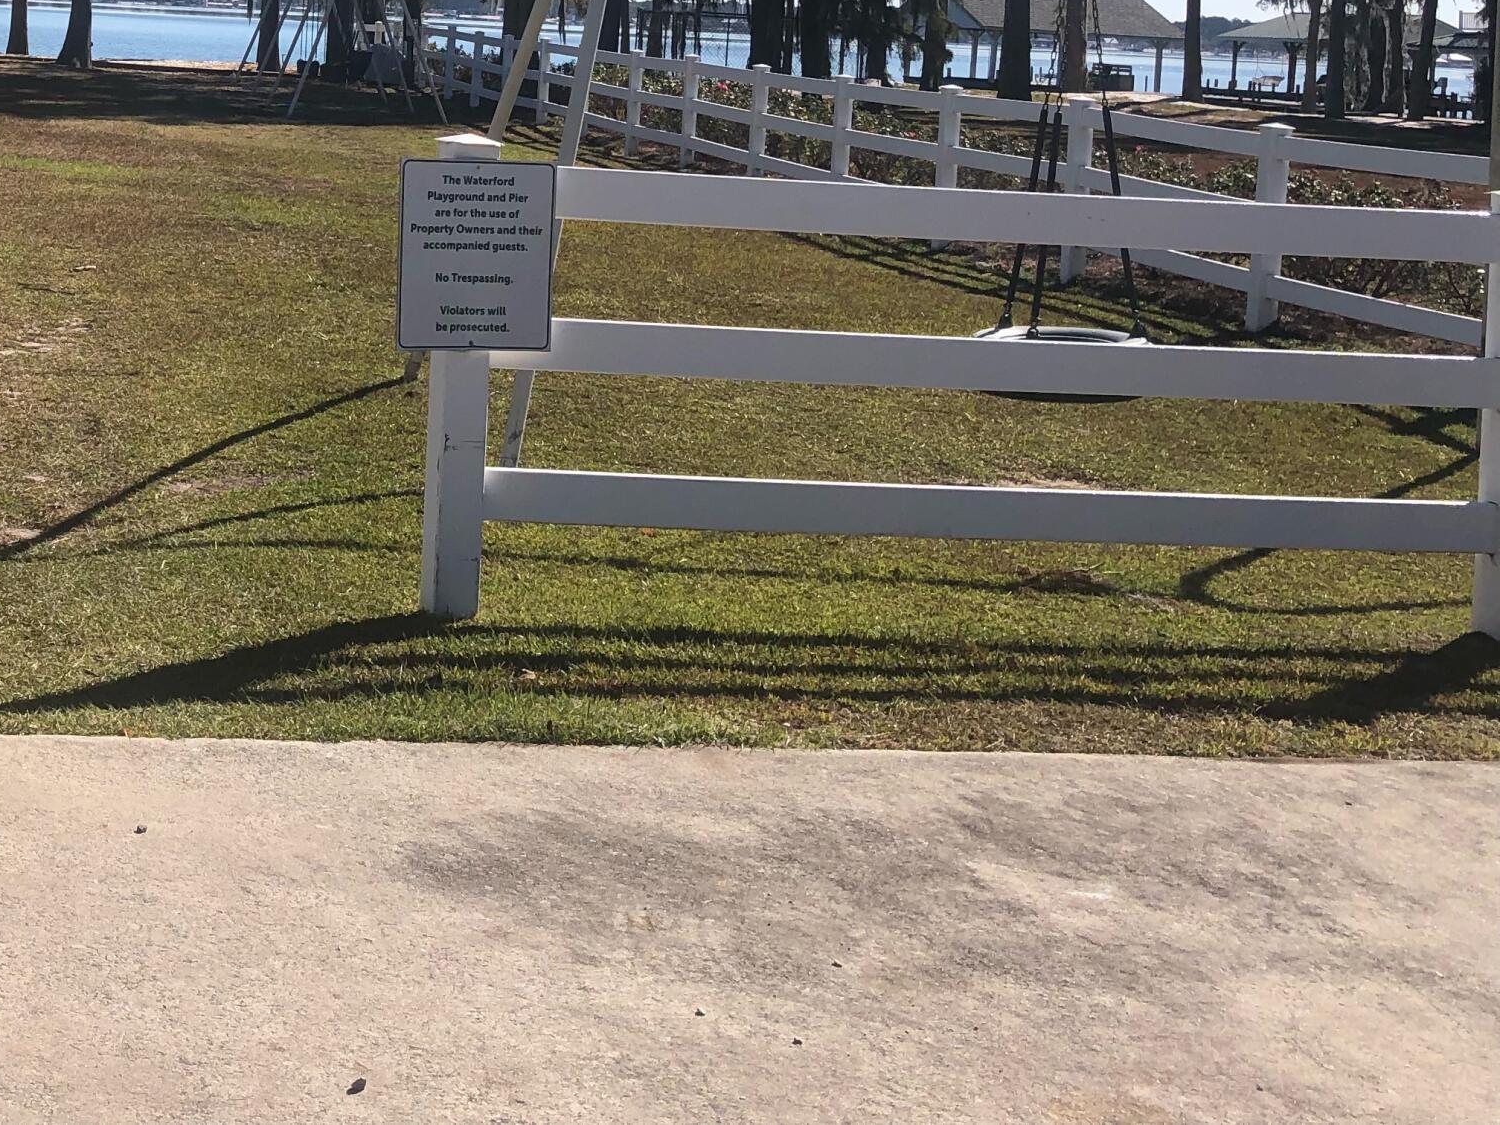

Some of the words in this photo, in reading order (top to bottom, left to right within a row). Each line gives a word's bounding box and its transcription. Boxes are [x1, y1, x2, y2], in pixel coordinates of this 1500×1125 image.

[442, 175, 461, 185] The
[464, 176, 514, 186] Waterford
[428, 191, 484, 203] Playground
[487, 193, 505, 202] and
[509, 193, 528, 203] Pier
[435, 209, 450, 217] are
[453, 208, 467, 218] for
[470, 208, 486, 218] the
[489, 210, 506, 218] use
[509, 210, 520, 218] of
[411, 224, 454, 235] Property
[457, 225, 494, 234] Owners
[497, 226, 515, 235] and
[519, 226, 543, 235] their
[423, 241, 490, 251] accompanied
[493, 243, 528, 253] guests.
[435, 273, 449, 283] No
[452, 273, 513, 285] Trespassing.
[440, 306, 484, 315] Violators
[487, 306, 506, 315] will
[436, 322, 447, 331] be
[450, 322, 509, 333] prosecuted.
